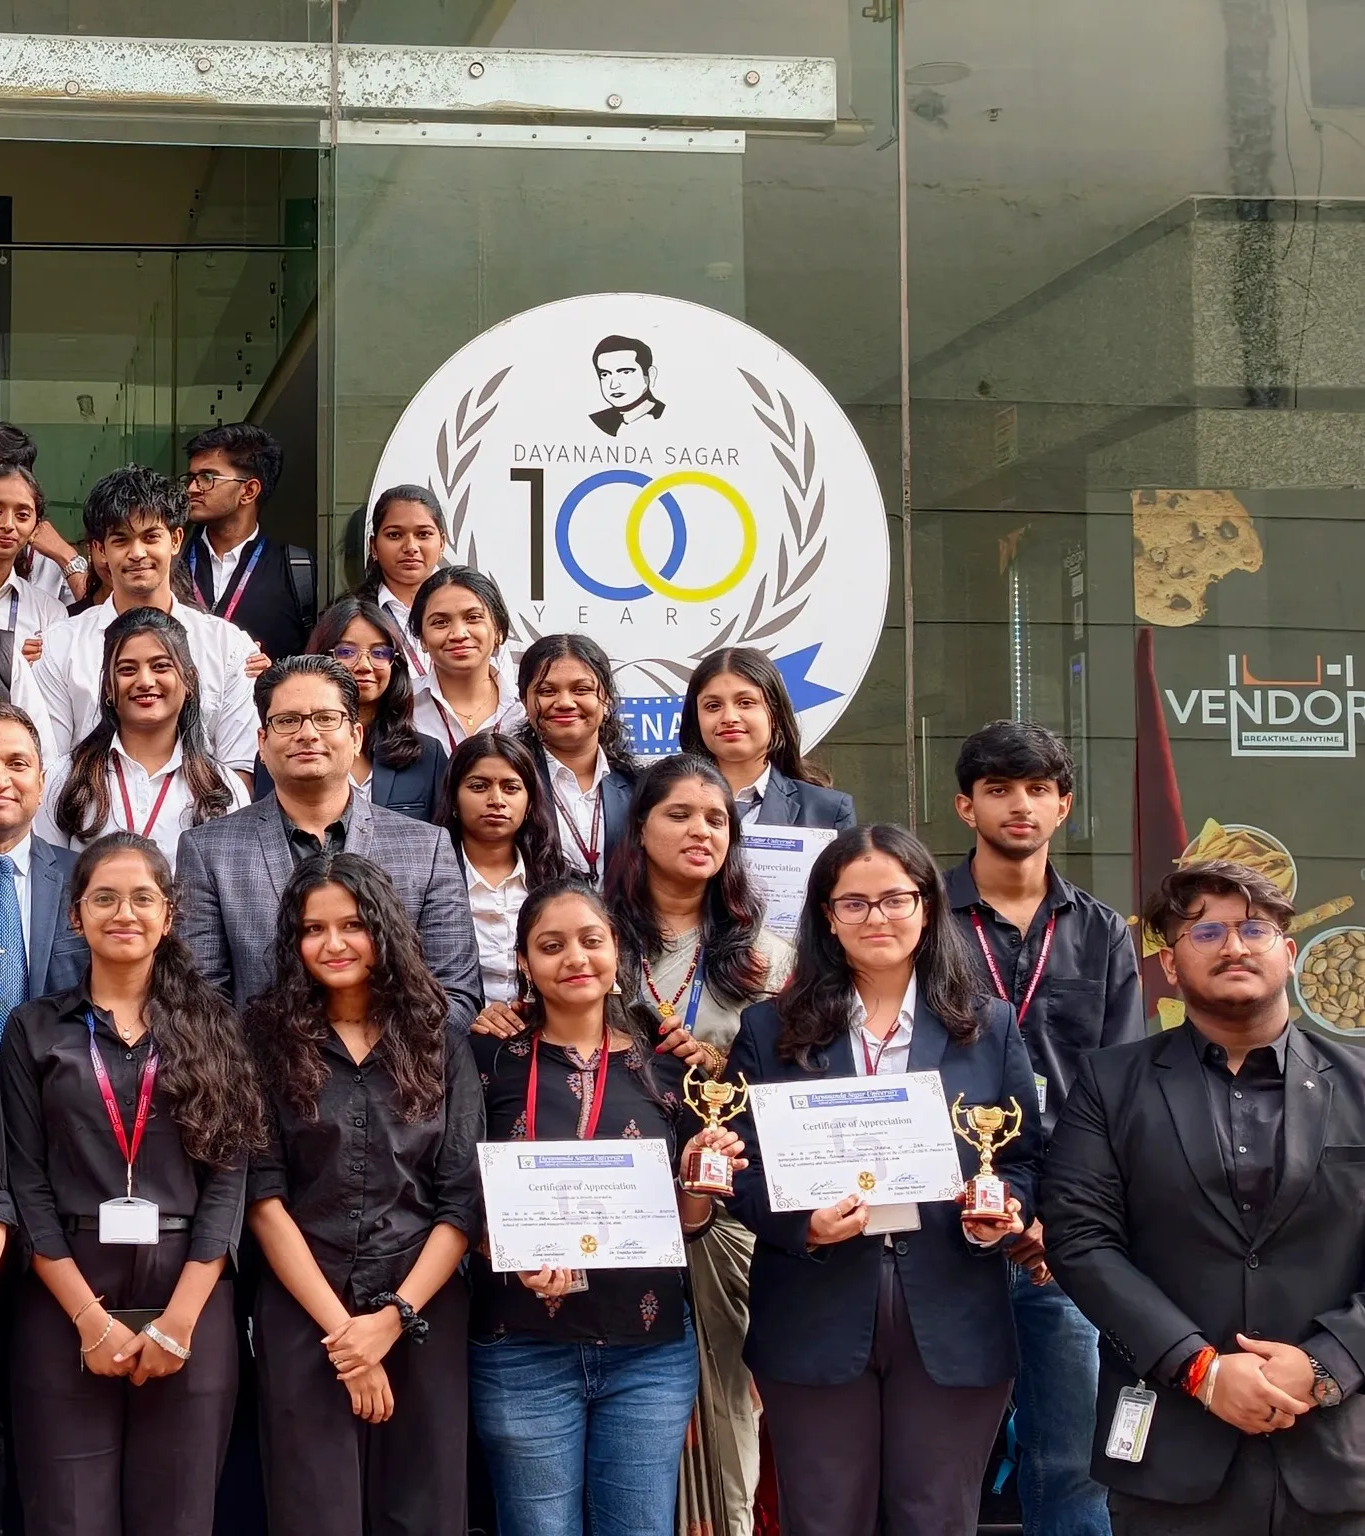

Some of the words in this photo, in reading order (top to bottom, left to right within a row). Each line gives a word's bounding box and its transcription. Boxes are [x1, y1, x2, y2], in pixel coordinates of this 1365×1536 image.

[513, 443, 654, 465] DAYANANDA
[664, 446, 740, 466] SAGAR
[510, 468, 757, 603] 100
[533, 605, 722, 627] YEARS
[1244, 735, 1298, 743] BREAKTIME.
[1300, 735, 1342, 743] ANYTIME.
[803, 1121, 846, 1131] Certificate
[848, 1119, 858, 1128] of
[859, 1117, 912, 1129] Appreciation
[528, 1183, 572, 1192] Certificate
[574, 1181, 583, 1191] of
[584, 1182, 637, 1193] Appreciation
